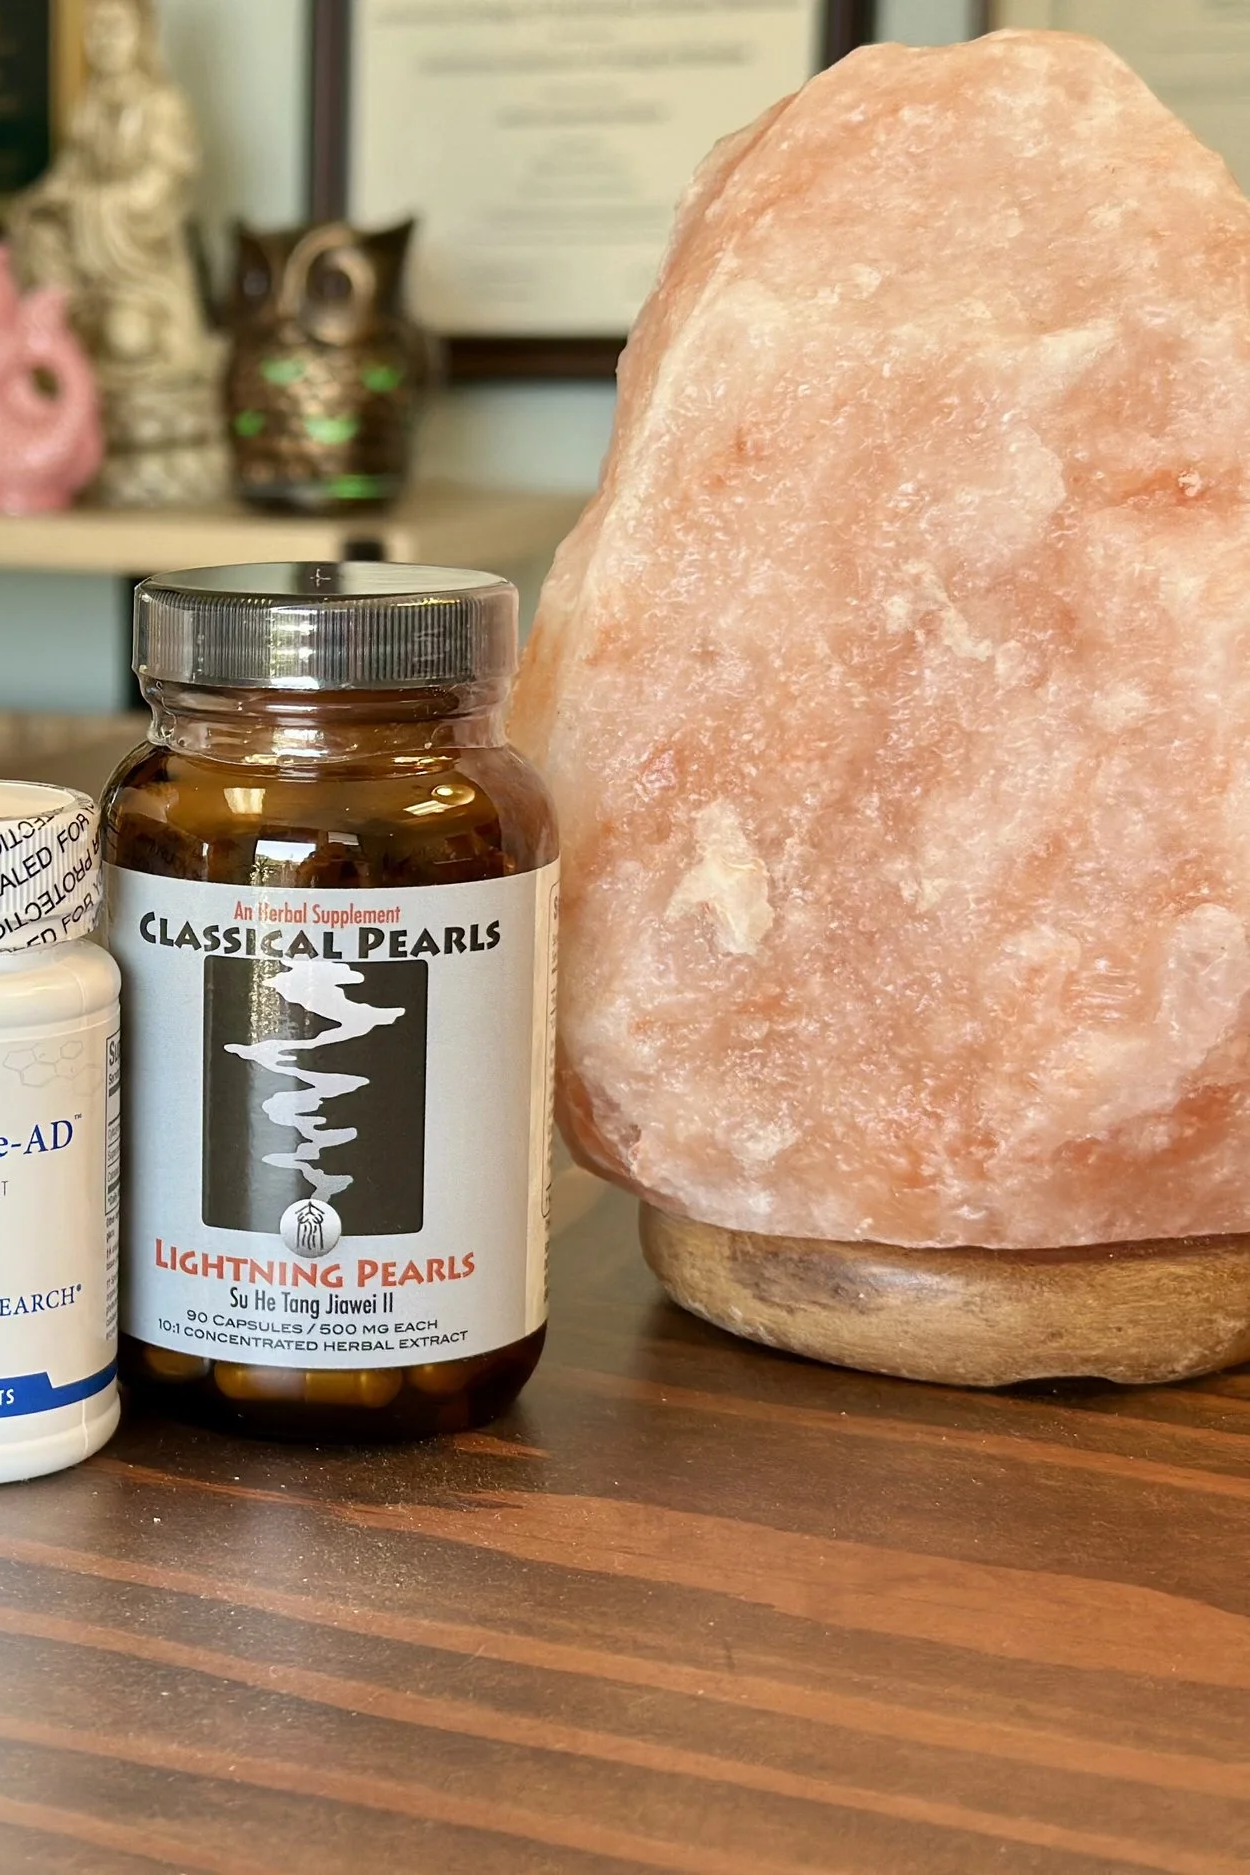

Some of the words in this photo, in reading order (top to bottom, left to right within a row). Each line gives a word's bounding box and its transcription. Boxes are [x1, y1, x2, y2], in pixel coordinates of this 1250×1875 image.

[56, 813, 90, 853] FOR
[61, 892, 95, 934] FOR
[234, 900, 253, 921] An
[258, 902, 307, 924] Herbal
[312, 903, 400, 929] Supplement
[139, 911, 343, 960] CLASSICAL
[359, 920, 501, 959] PEARLS
[155, 1239, 344, 1289] LIGHTNING
[357, 1251, 476, 1289] PEARLS
[230, 1287, 248, 1309] Su
[255, 1291, 276, 1313] He
[281, 1292, 320, 1319] Tang
[325, 1292, 377, 1315] Jiawei
[383, 1292, 394, 1313] II
[158, 1318, 181, 1334] 10:1
[184, 1326, 318, 1351] CONCENTRATED
[323, 1339, 395, 1351] HERBAL
[399, 1330, 469, 1350] EXTRACT
[187, 1309, 208, 1323] 90
[213, 1314, 303, 1335] CAPSULES
[306, 1323, 316, 1336] /
[319, 1323, 357, 1335] 500
[363, 1323, 389, 1335] MG
[394, 1319, 438, 1333] EACH
